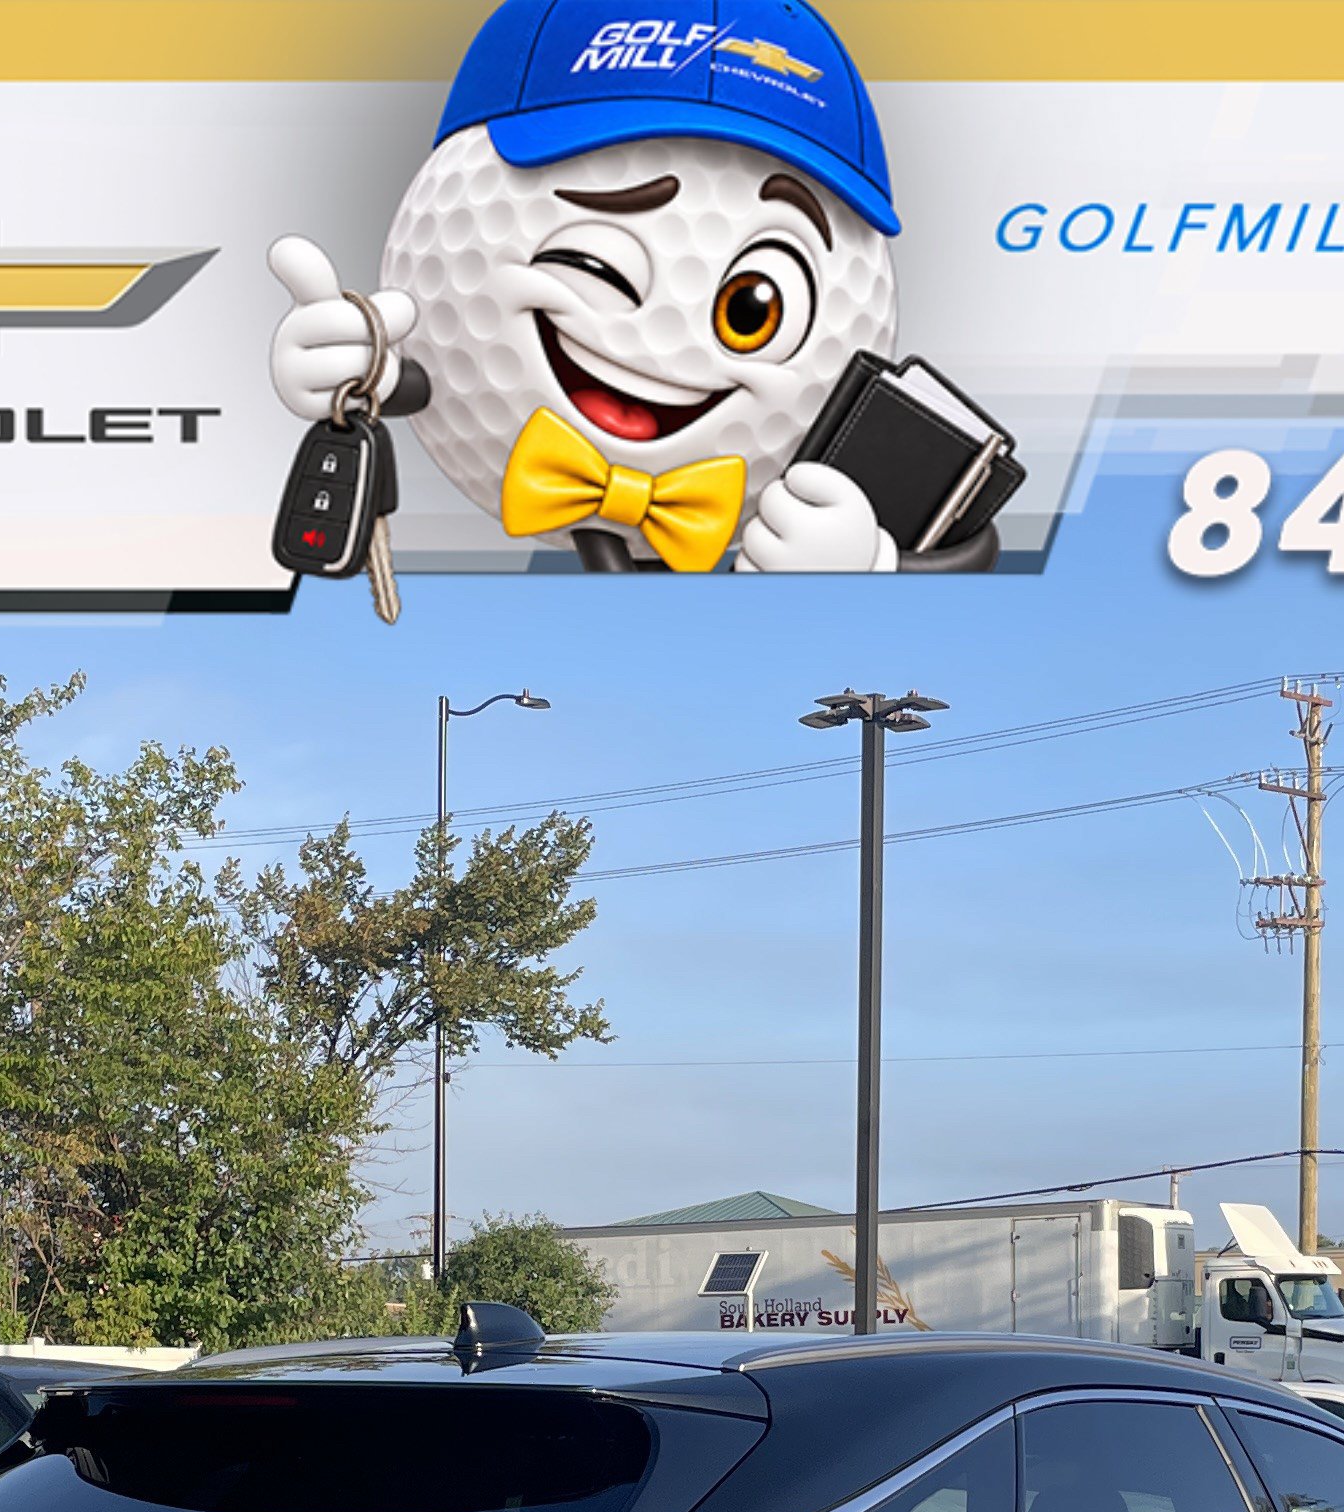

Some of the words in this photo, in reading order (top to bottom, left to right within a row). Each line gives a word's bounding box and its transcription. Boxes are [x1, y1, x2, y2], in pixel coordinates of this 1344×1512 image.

[719, 1300, 759, 1315] Souh
[764, 1297, 823, 1314] Holland
[817, 1308, 909, 1326] SULY
